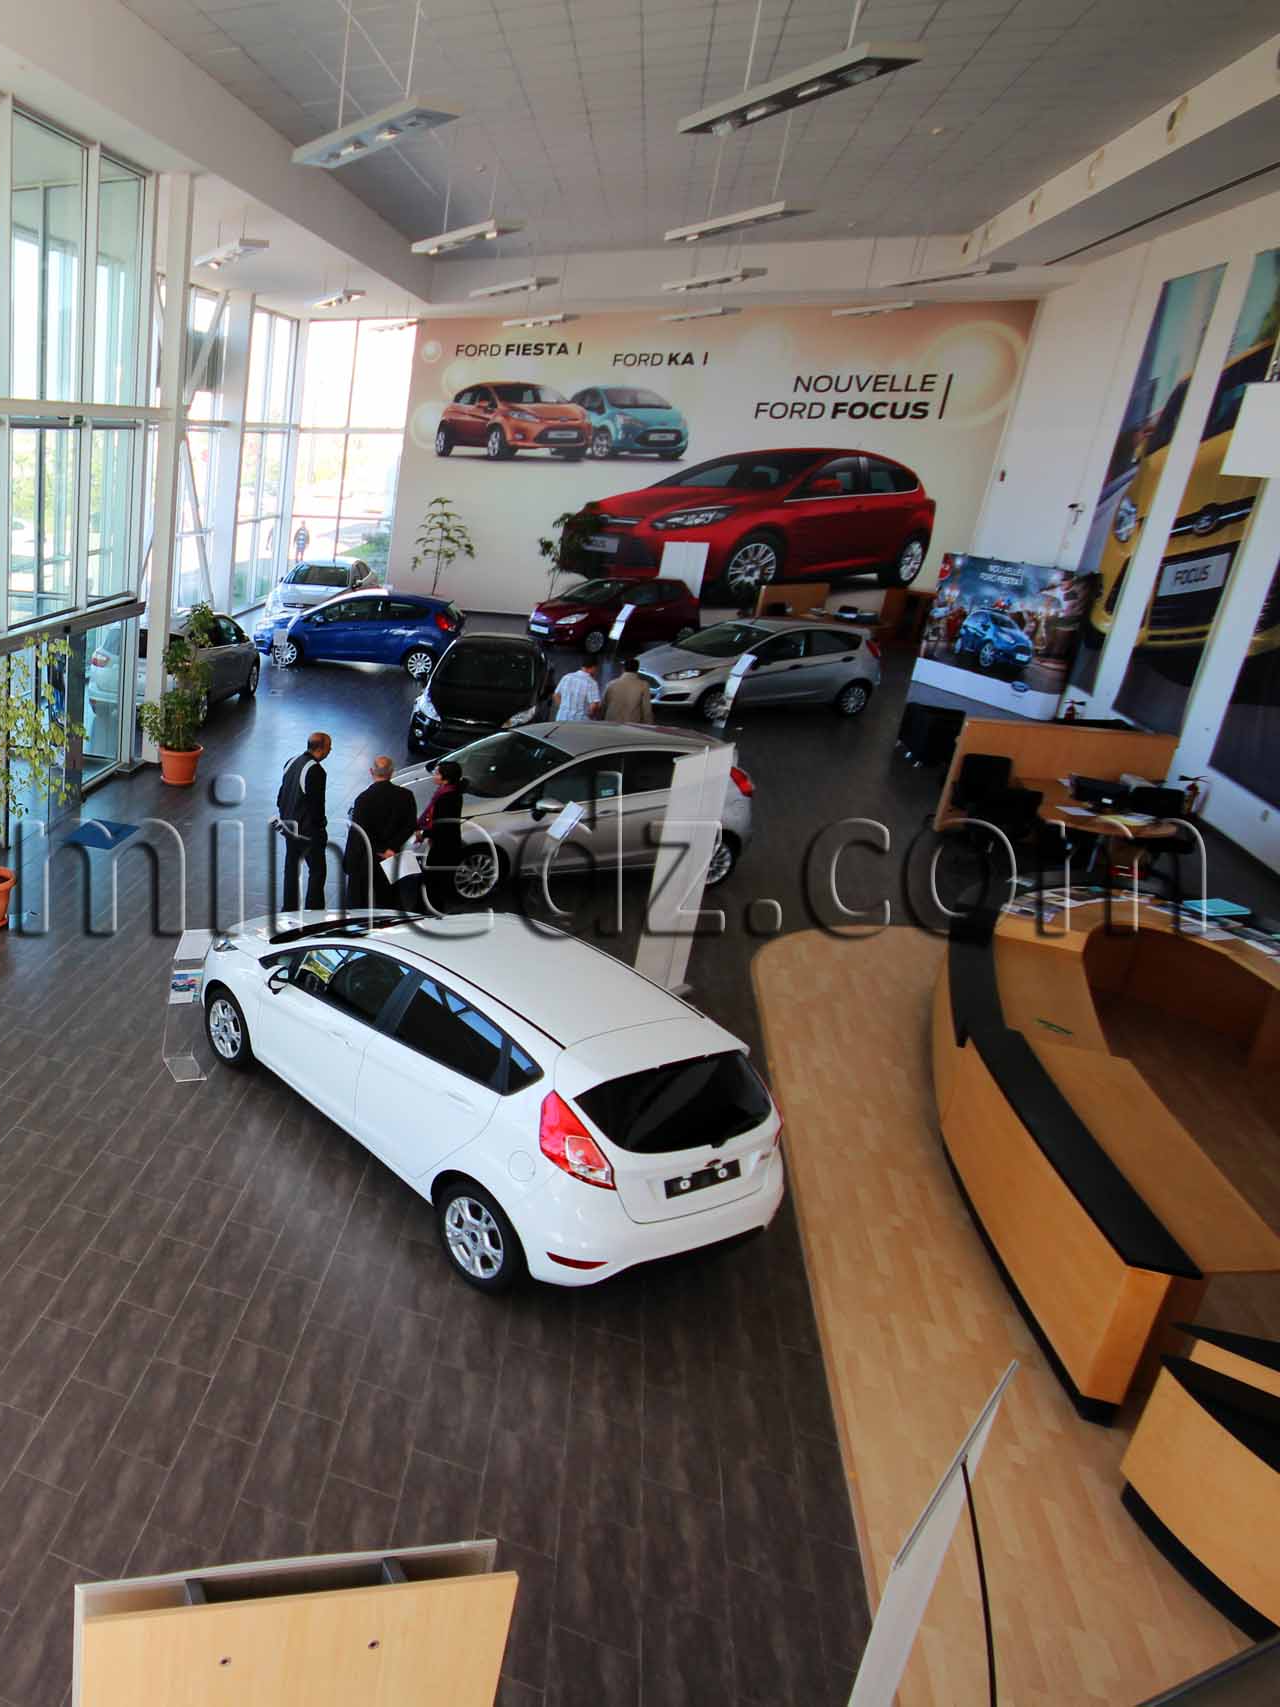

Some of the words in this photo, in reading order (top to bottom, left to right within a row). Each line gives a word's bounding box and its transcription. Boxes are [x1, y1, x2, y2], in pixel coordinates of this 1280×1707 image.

[455, 343, 501, 357] FORD
[505, 342, 569, 356] FIESTA
[612, 353, 664, 367] FORD
[667, 352, 695, 366] KA
[793, 374, 938, 393] NOUVELLE
[754, 402, 825, 420] FORD
[831, 401, 930, 420] FOCUS
[1174, 564, 1211, 585] FOCUS
